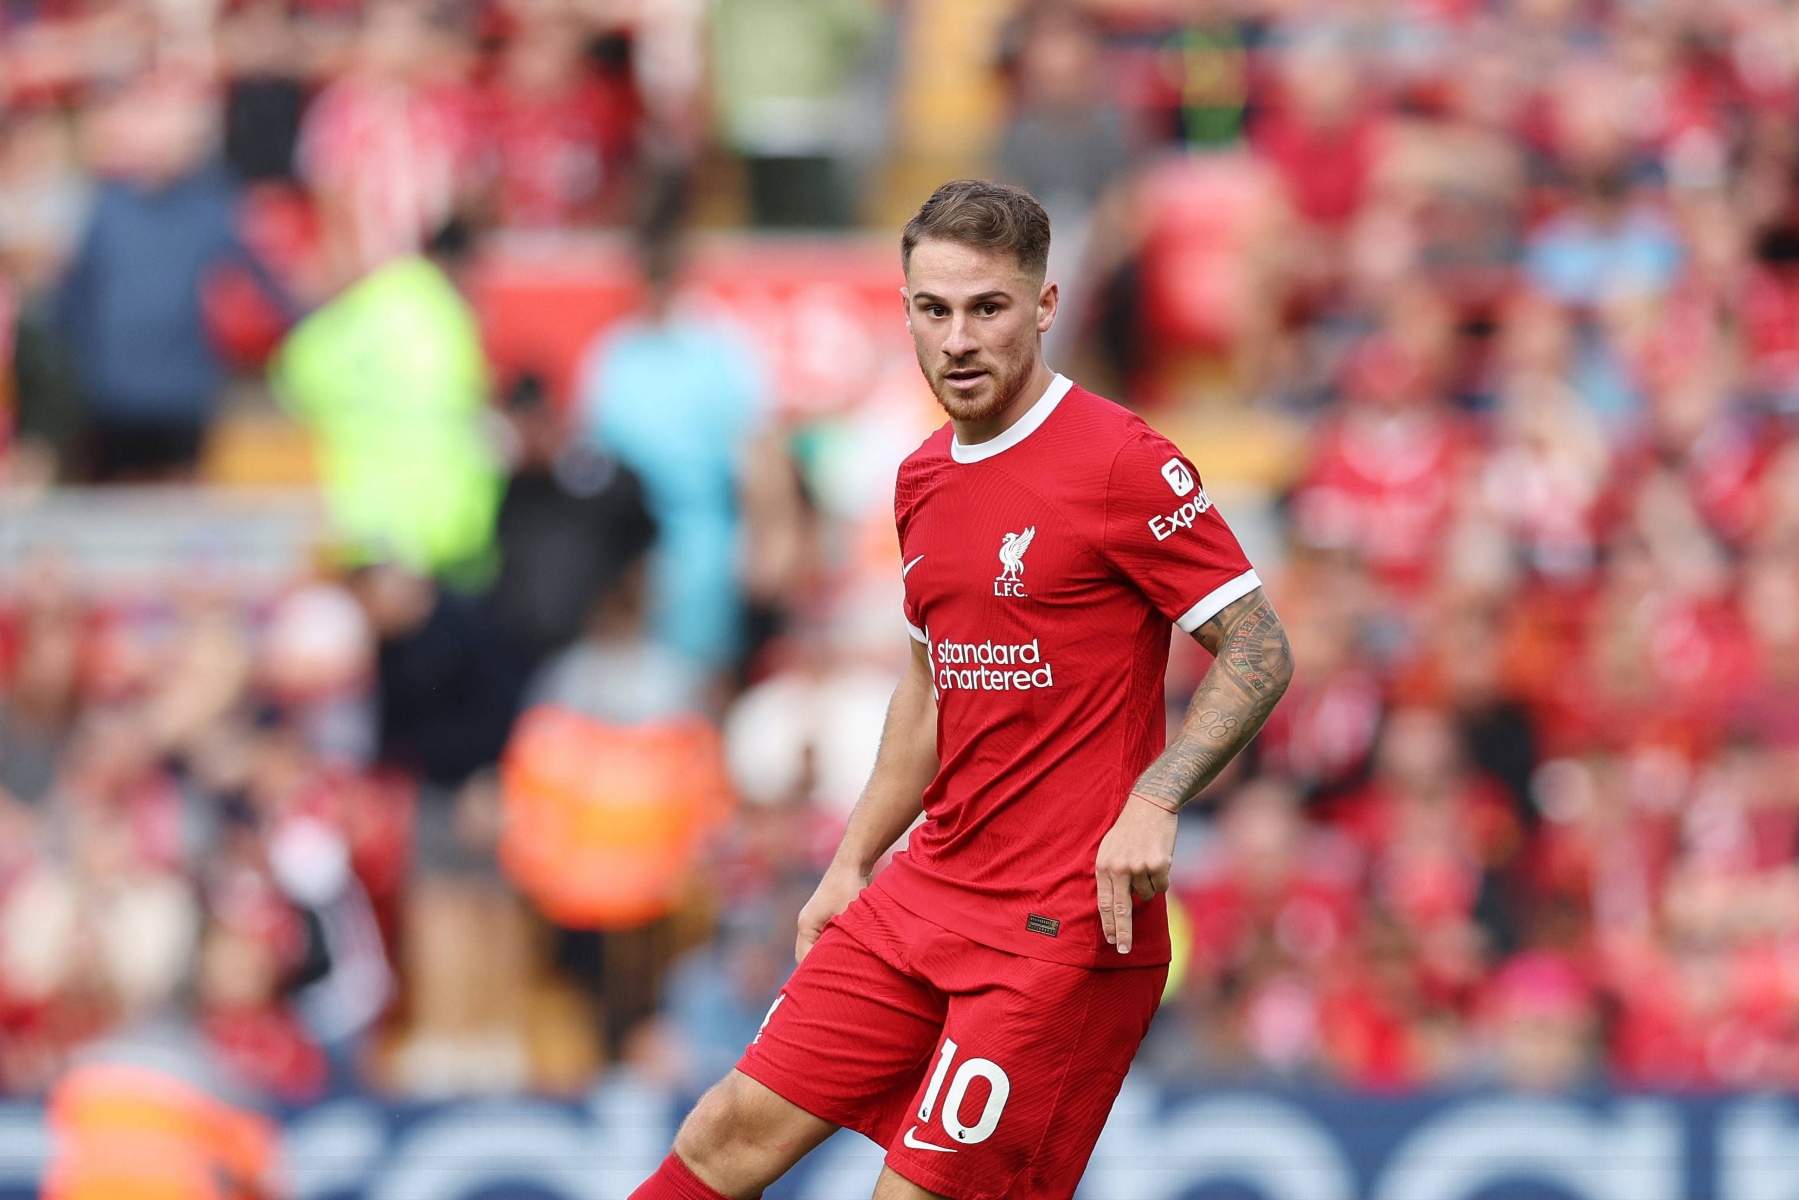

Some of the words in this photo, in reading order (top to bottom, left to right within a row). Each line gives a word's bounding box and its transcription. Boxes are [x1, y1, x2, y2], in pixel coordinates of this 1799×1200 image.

[993, 581, 1028, 597] L.F.C.
[937, 638, 1040, 665] standard
[939, 663, 1053, 690] chartered
[917, 1037, 1010, 1145] 10
